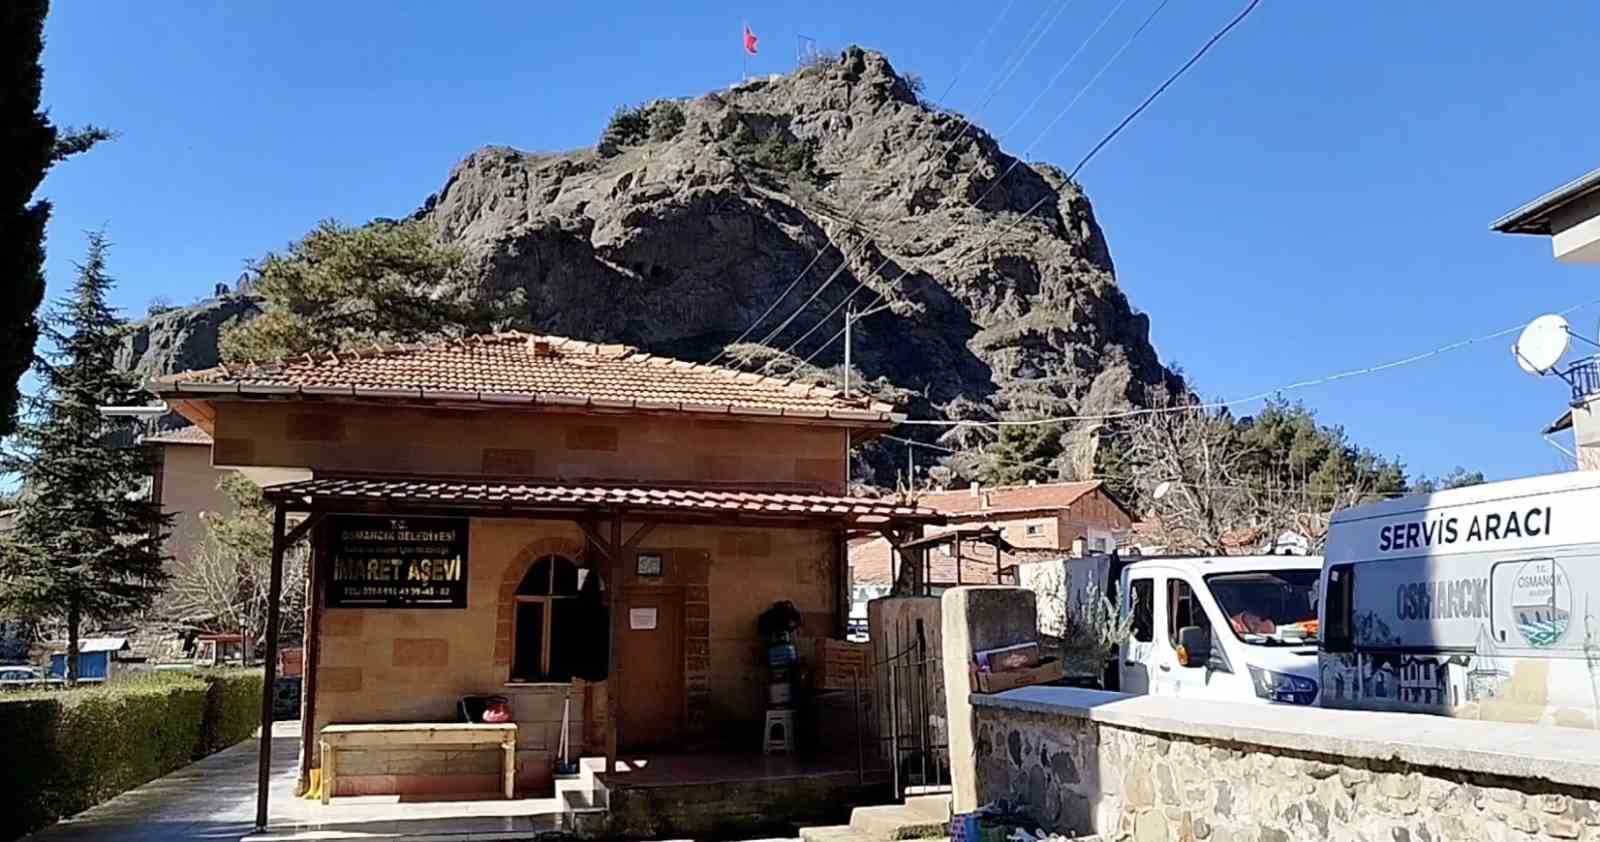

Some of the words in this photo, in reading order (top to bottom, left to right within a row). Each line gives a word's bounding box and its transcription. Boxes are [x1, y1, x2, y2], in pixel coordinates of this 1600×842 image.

[1379, 512, 1459, 552] SERVİS
[1466, 507, 1552, 541] ARACI
[333, 555, 402, 581] İMARET
[407, 554, 461, 586] AŞEVİ
[1518, 574, 1562, 588] OSMANCK
[1396, 577, 1490, 621] OSMANCIK
